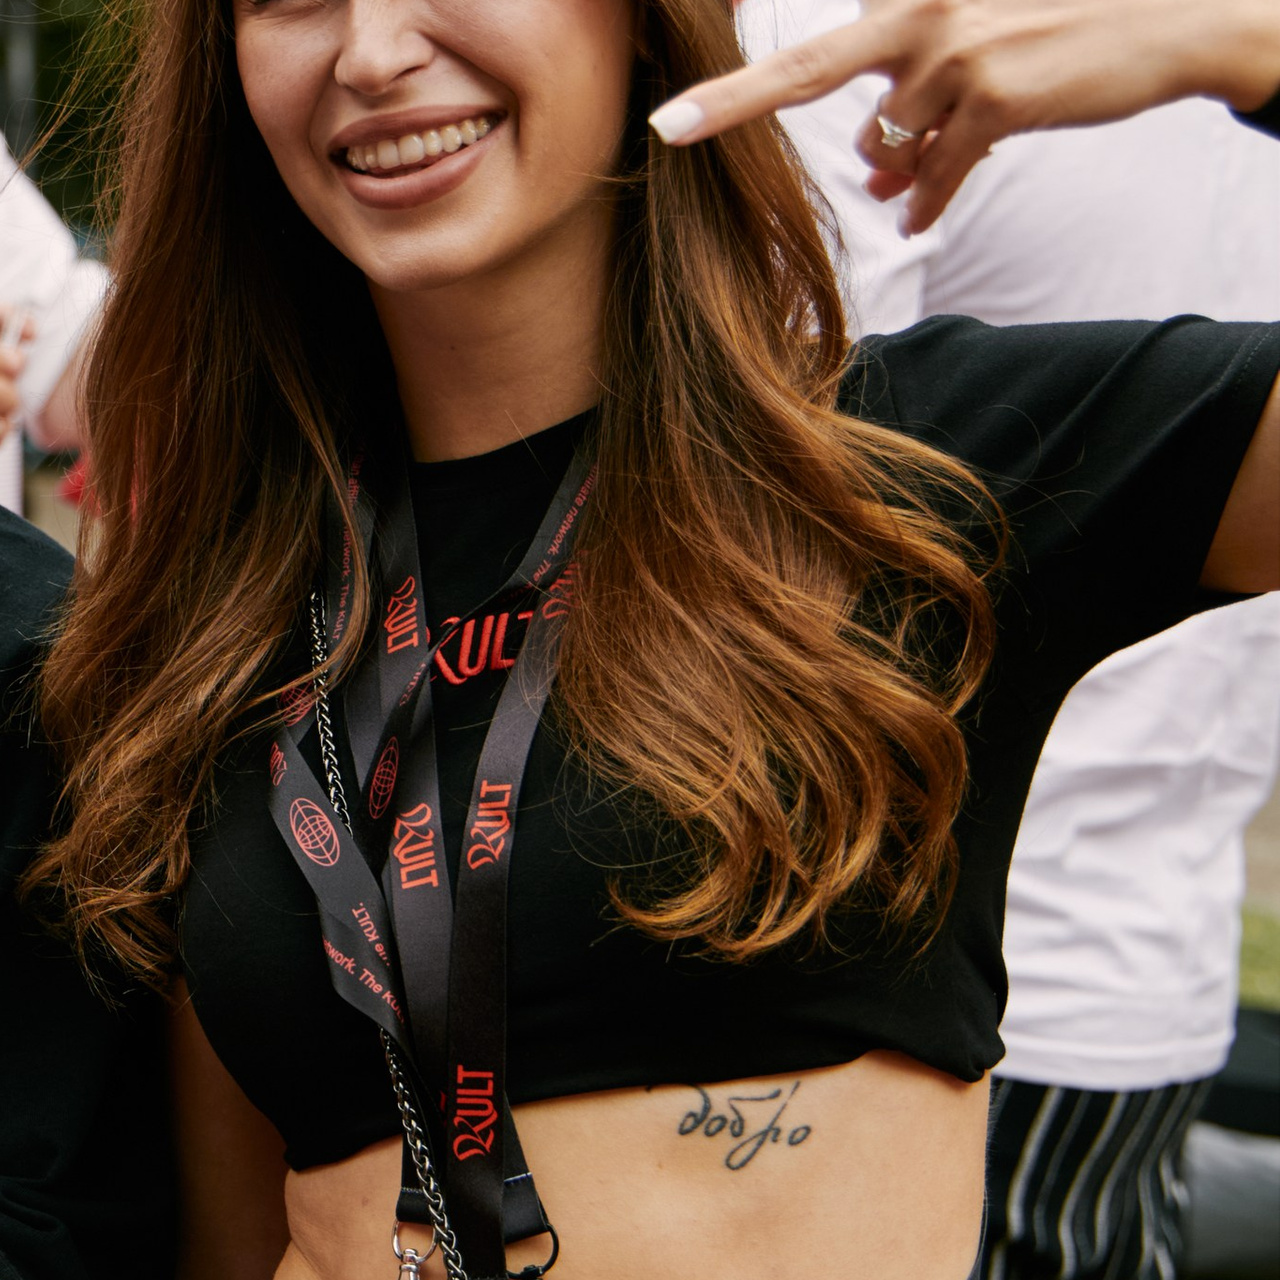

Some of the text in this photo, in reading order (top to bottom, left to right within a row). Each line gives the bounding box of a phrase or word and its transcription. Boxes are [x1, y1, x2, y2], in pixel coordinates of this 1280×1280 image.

[383, 575, 419, 654] KULT
[393, 802, 439, 890] KULT
[466, 779, 513, 870] KULT
[358, 968, 383, 995] The
[452, 1064, 498, 1161] KULT
